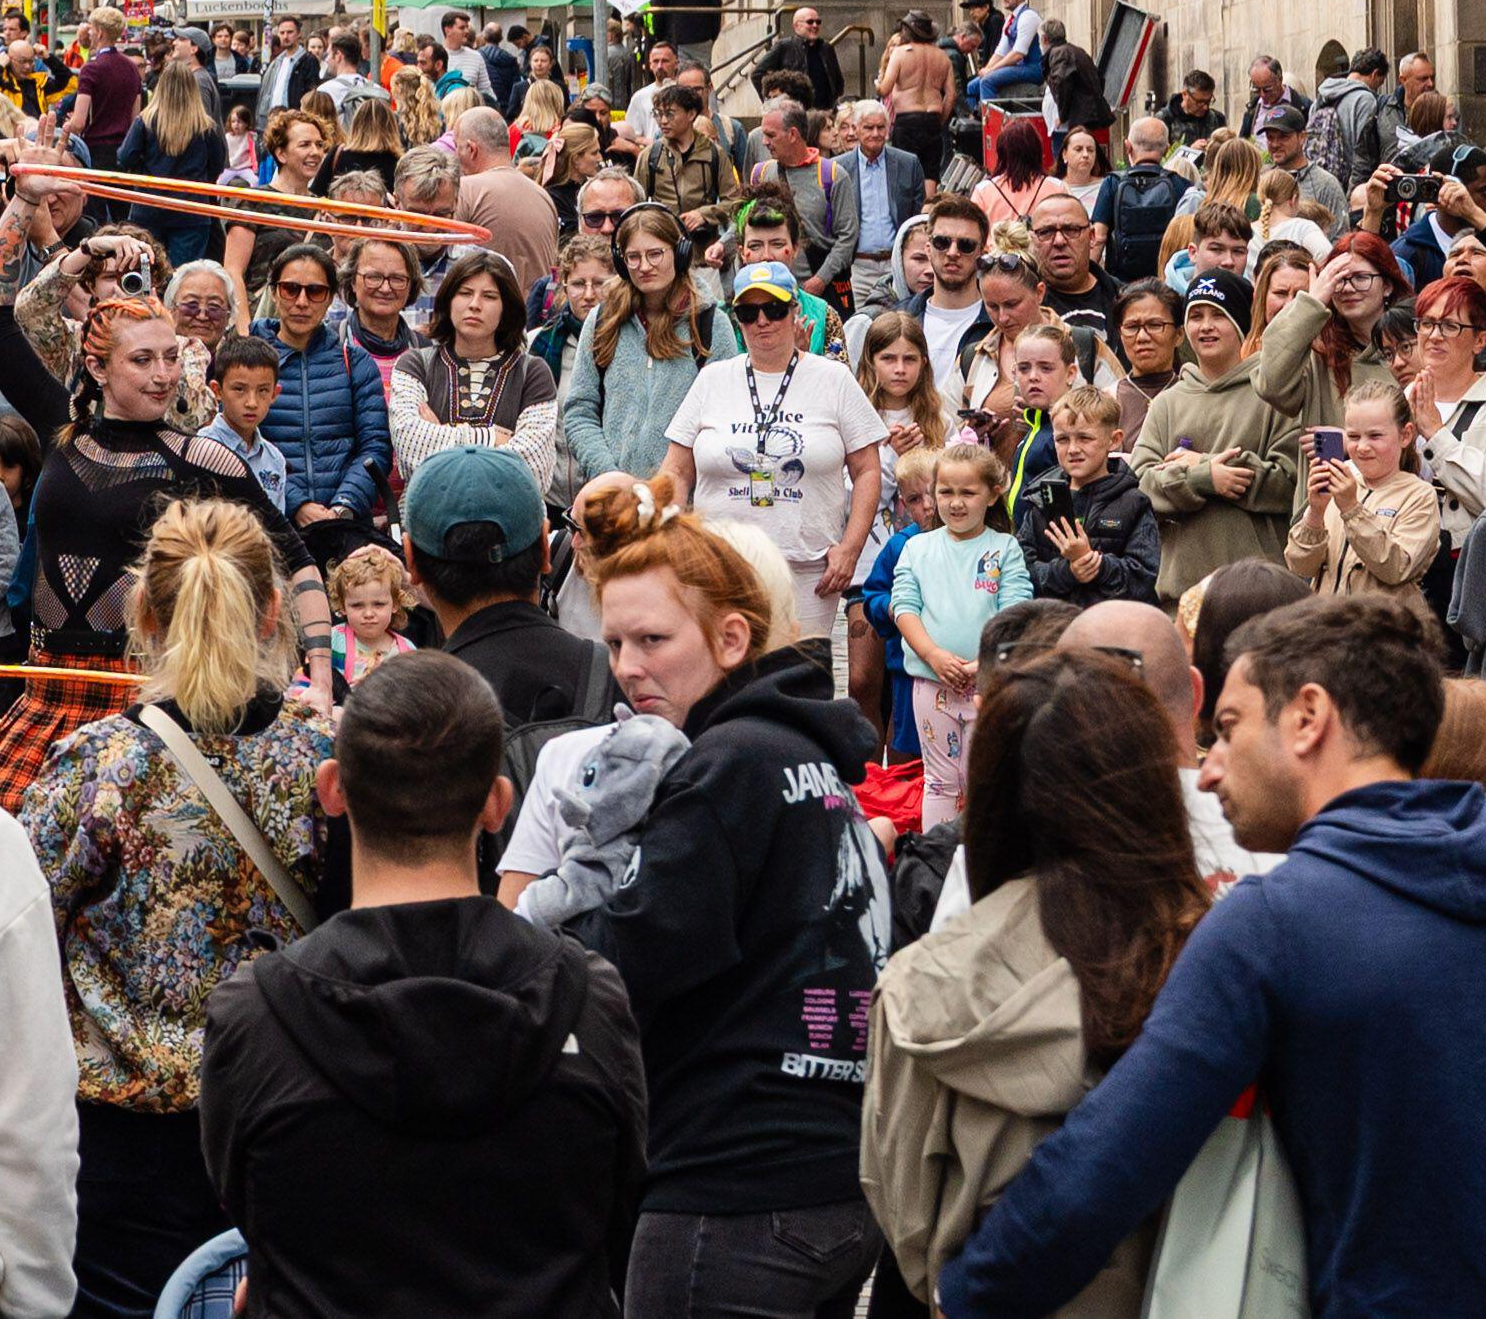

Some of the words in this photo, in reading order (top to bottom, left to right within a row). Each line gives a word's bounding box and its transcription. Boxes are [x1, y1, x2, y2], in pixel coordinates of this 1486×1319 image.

[728, 486, 750, 497] Shell
[783, 487, 804, 499] Club
[783, 762, 843, 804] JAME
[804, 997, 835, 1005] COLOGNE
[781, 1052, 854, 1081] BITTER
